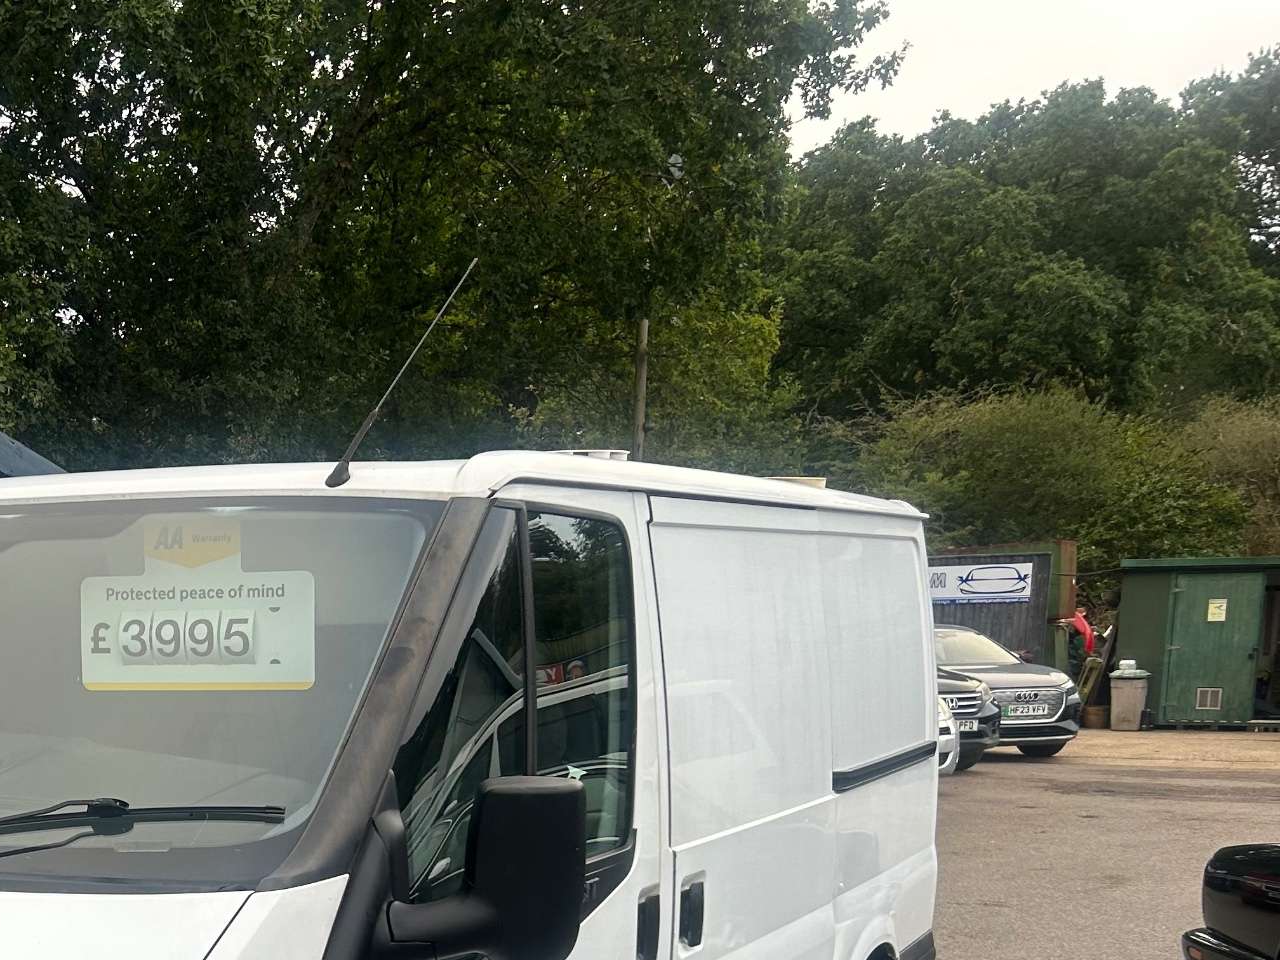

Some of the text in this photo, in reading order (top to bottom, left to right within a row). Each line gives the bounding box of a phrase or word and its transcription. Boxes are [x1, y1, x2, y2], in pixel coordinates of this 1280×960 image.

[154, 524, 232, 550] AA Warranty
[106, 584, 286, 602] Protected peace of mind
